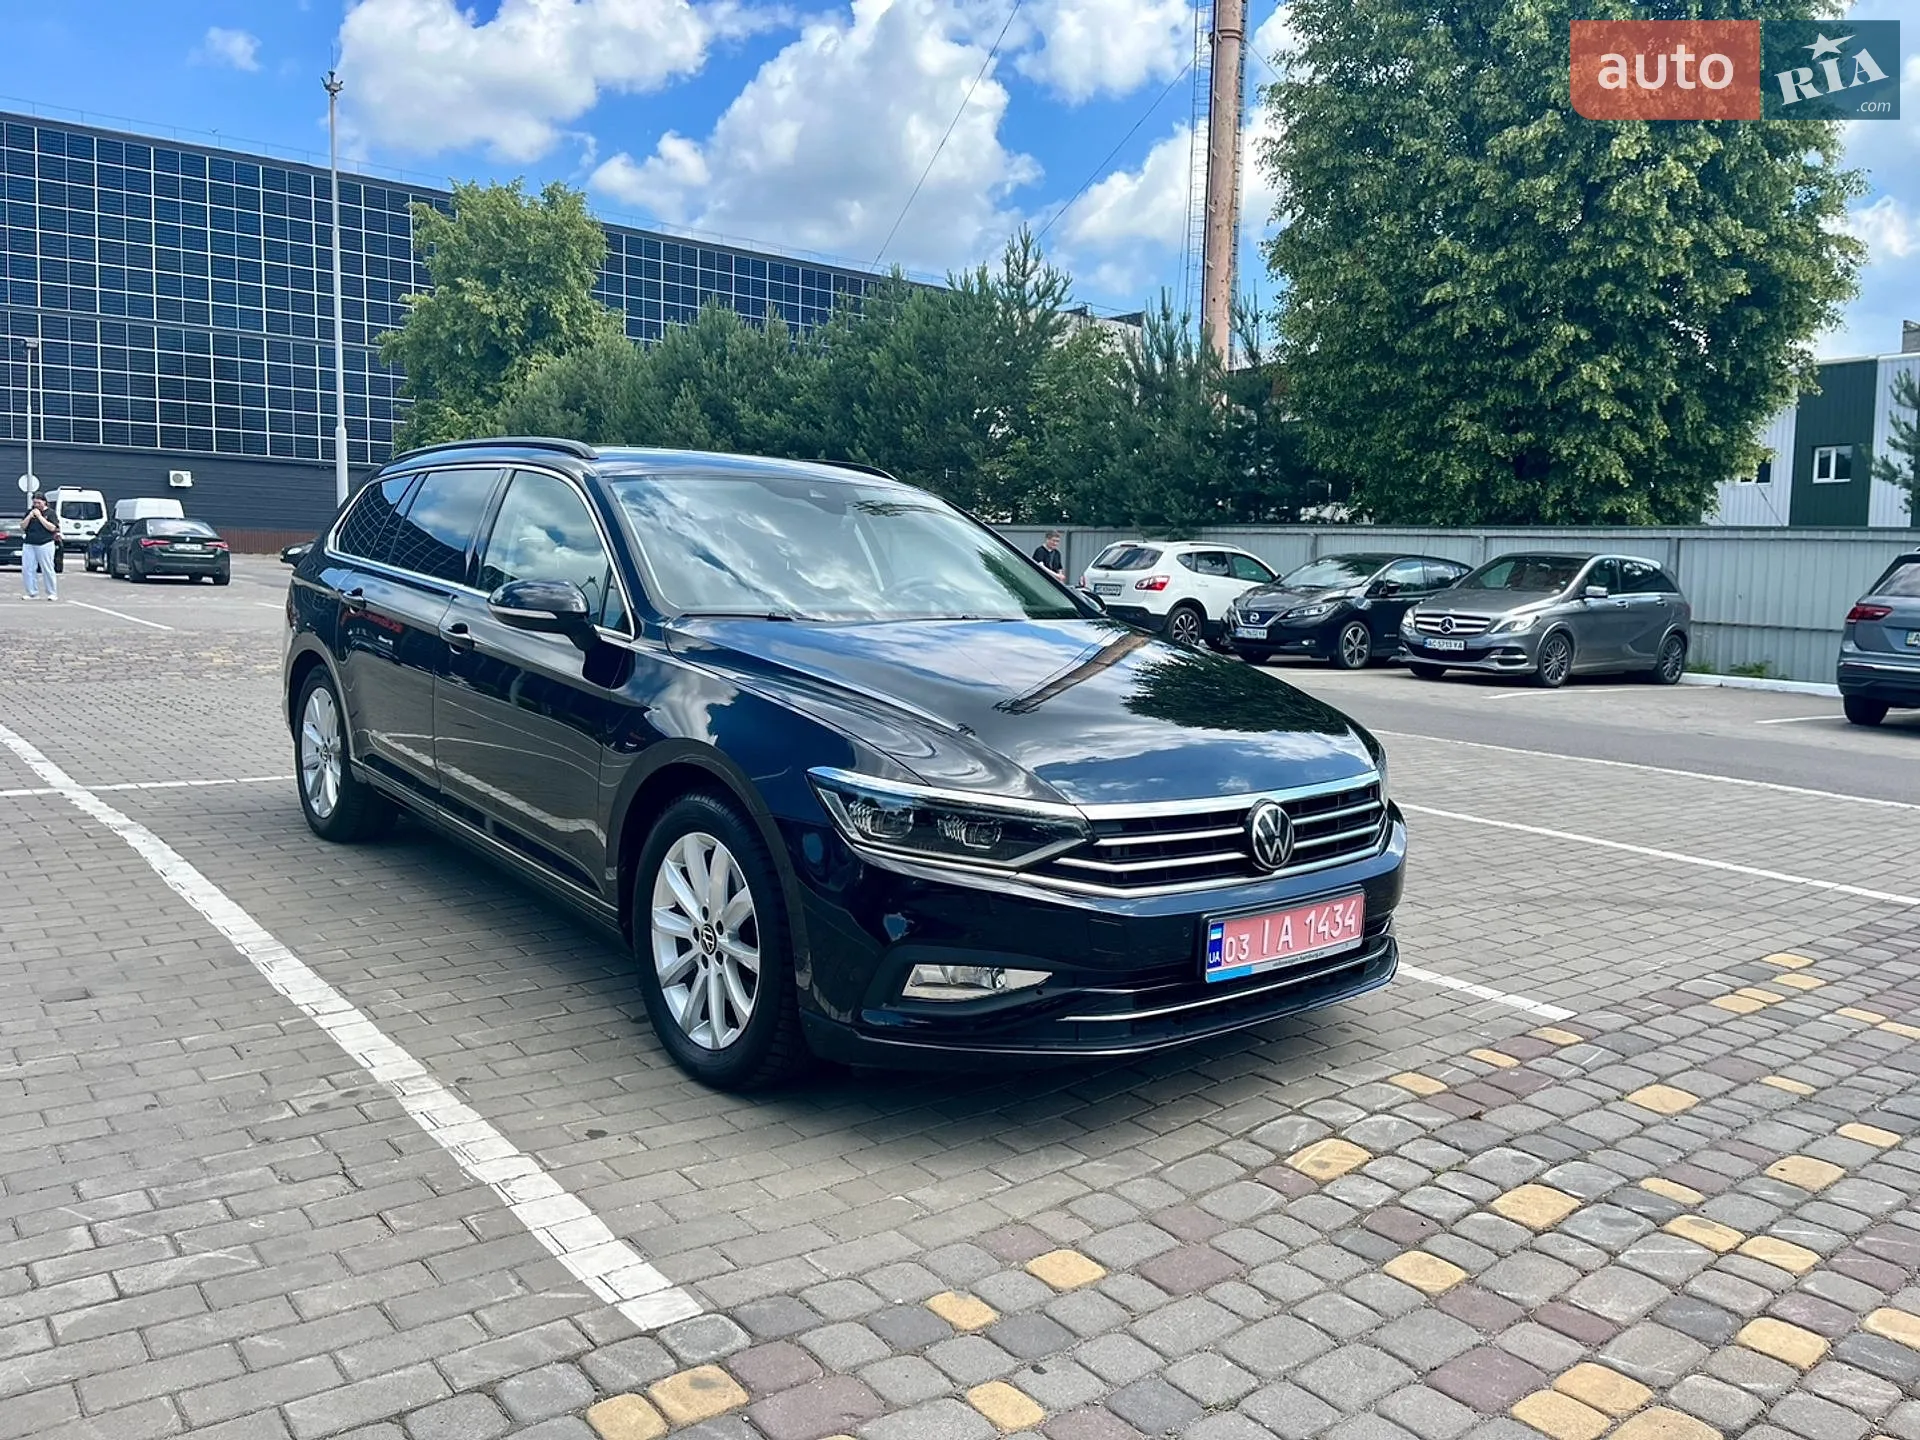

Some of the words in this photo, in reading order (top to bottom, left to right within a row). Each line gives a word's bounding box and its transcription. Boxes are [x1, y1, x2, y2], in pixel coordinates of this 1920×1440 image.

[1225, 933, 1250, 963] 03
[1263, 915, 1294, 955] IA
[1305, 900, 1357, 944] 1434
[1208, 951, 1221, 964] UA
